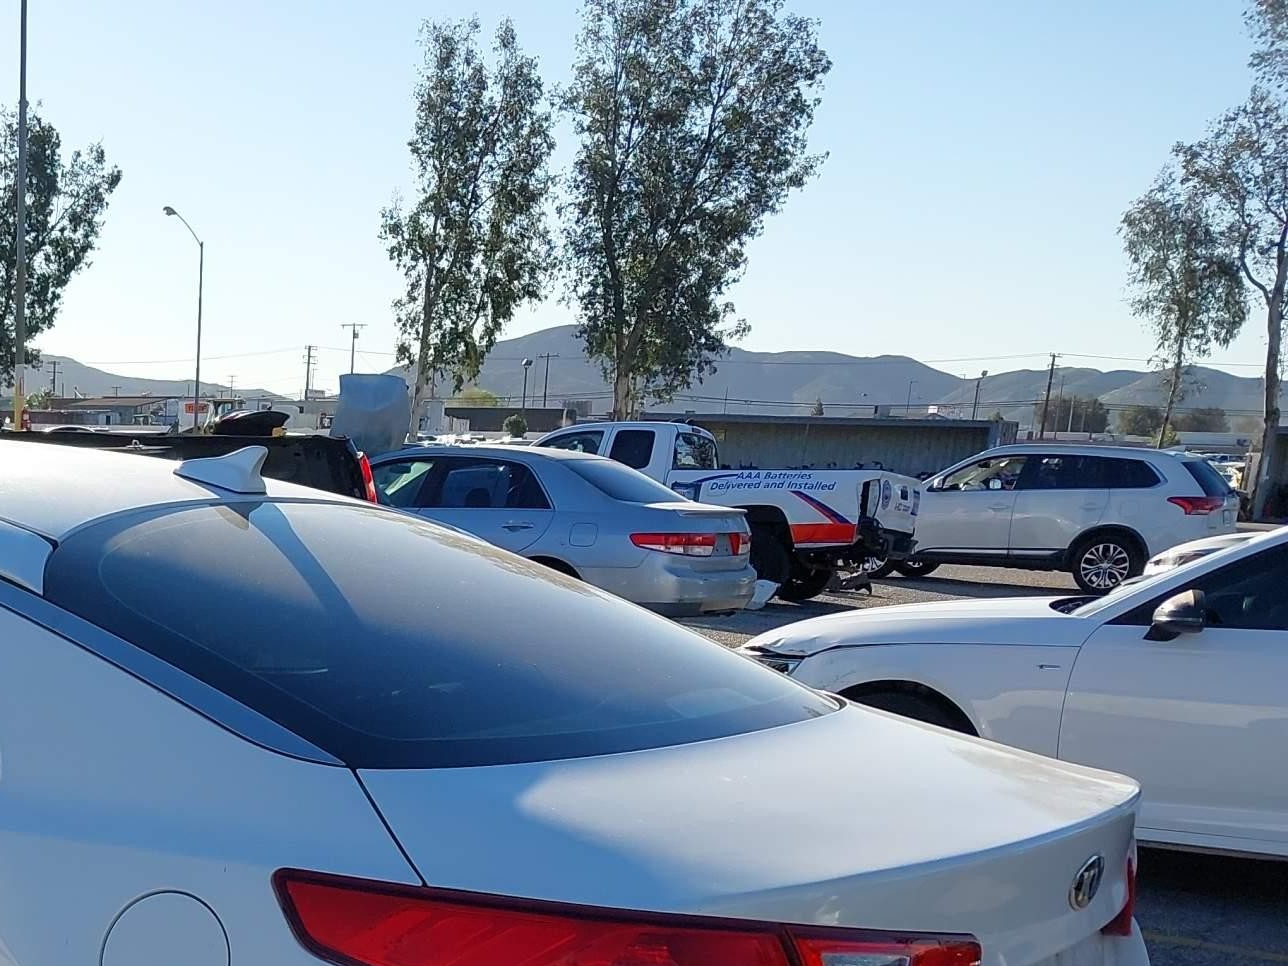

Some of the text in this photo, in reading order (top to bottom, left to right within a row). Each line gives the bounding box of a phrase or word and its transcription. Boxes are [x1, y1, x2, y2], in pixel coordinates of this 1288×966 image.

[736, 471, 813, 480] AAA Batteries
[710, 480, 836, 491] Delivered and Installed
